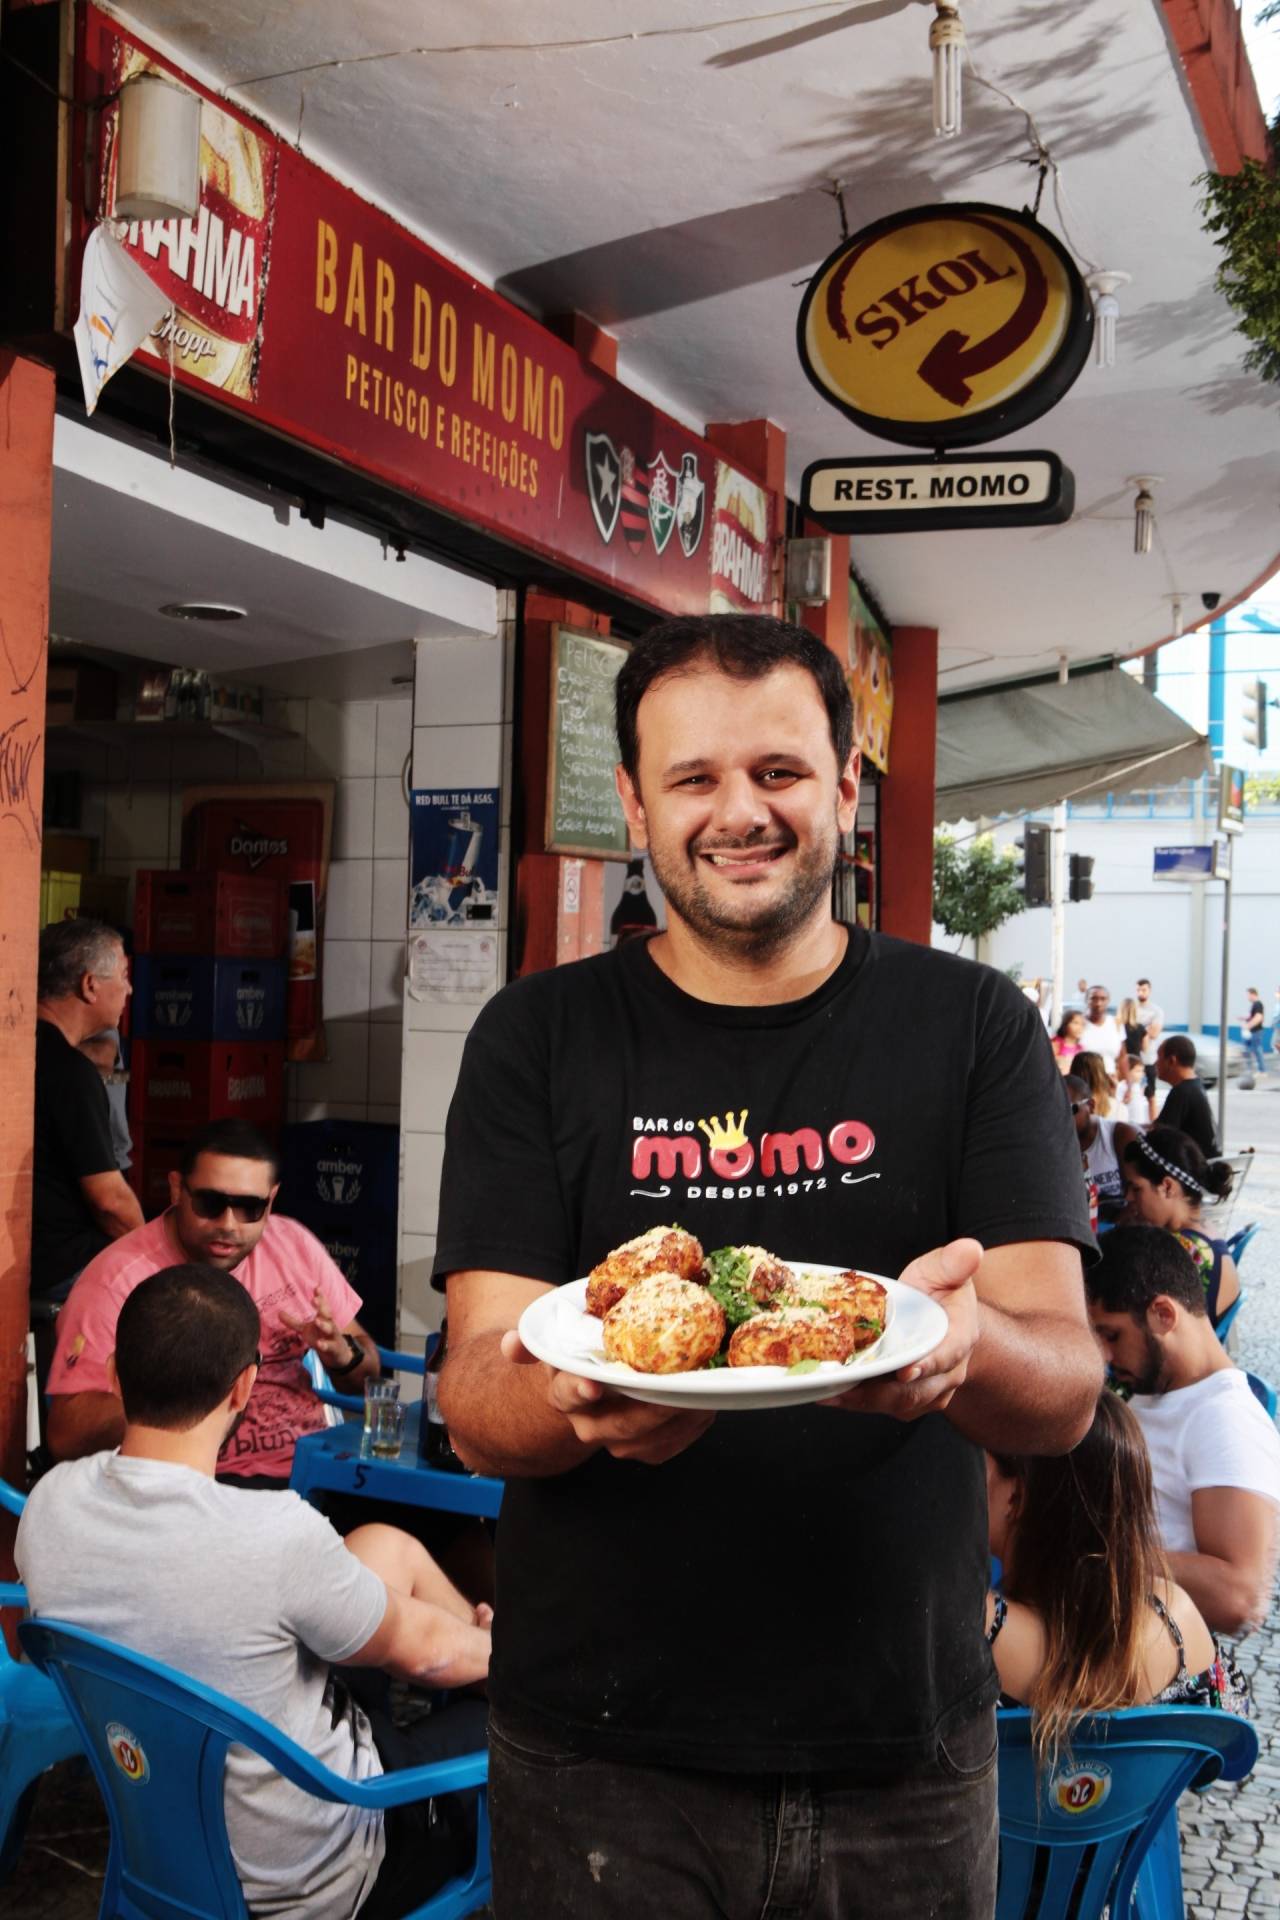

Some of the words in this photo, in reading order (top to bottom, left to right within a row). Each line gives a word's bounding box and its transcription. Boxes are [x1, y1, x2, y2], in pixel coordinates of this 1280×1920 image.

[854, 249, 1018, 351] SKOL
[315, 218, 396, 353] BAR
[411, 282, 458, 388] DO
[472, 322, 565, 451] MOMO
[345, 353, 430, 441] PETISCO
[435, 404, 446, 450] E
[451, 412, 539, 499] REFEIÇÕES
[833, 478, 918, 501] REST.
[929, 473, 1030, 500] MOMO
[415, 795, 431, 806] RED
[432, 795, 450, 806] BULL
[451, 794, 459, 805] TE
[231, 838, 288, 855] Doritos
[632, 1116, 669, 1132] BAR
[673, 1117, 695, 1132] do
[631, 1119, 876, 1180] momo
[317, 1159, 362, 1175] ambev
[687, 1185, 767, 1199] DESDE
[773, 1177, 828, 1197] 1972
[324, 1241, 360, 1257] mbev
[353, 1463, 372, 1489] 5
